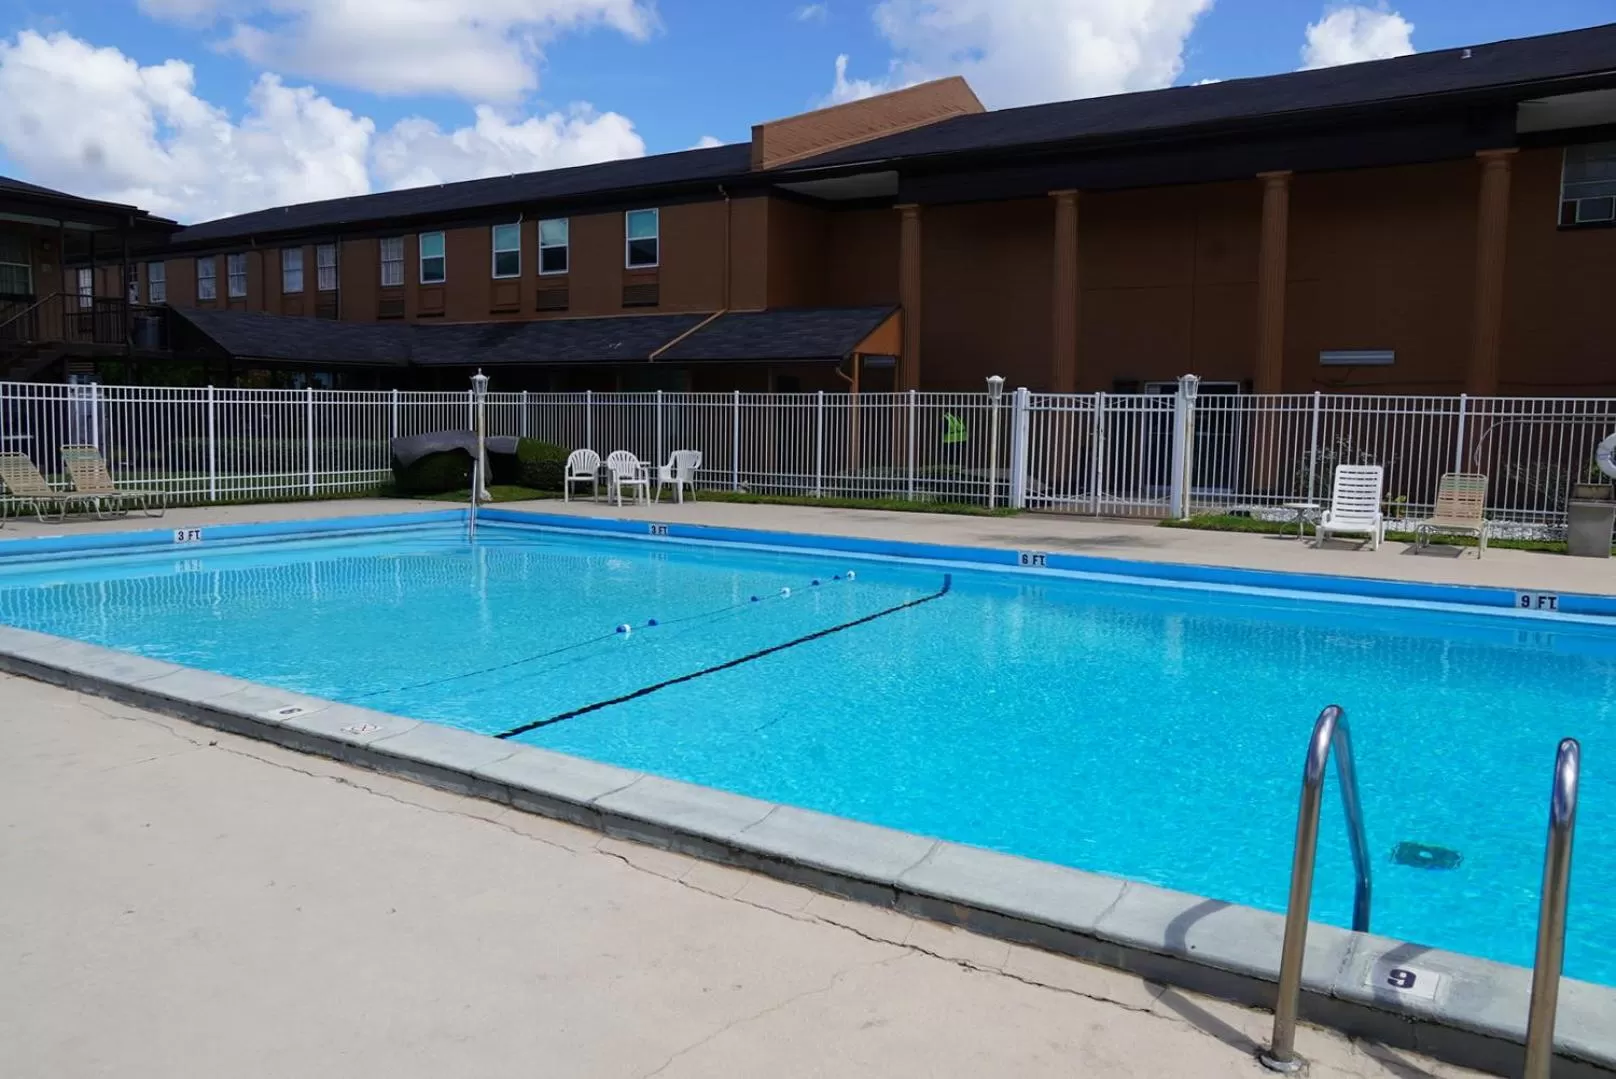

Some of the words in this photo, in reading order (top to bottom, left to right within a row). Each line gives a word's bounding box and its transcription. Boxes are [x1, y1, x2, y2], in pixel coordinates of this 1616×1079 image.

[651, 525, 656, 534] 3
[178, 530, 184, 541] 3
[1022, 554, 1029, 565] 6
[1521, 595, 1530, 608] 9
[1387, 969, 1417, 989] 9
